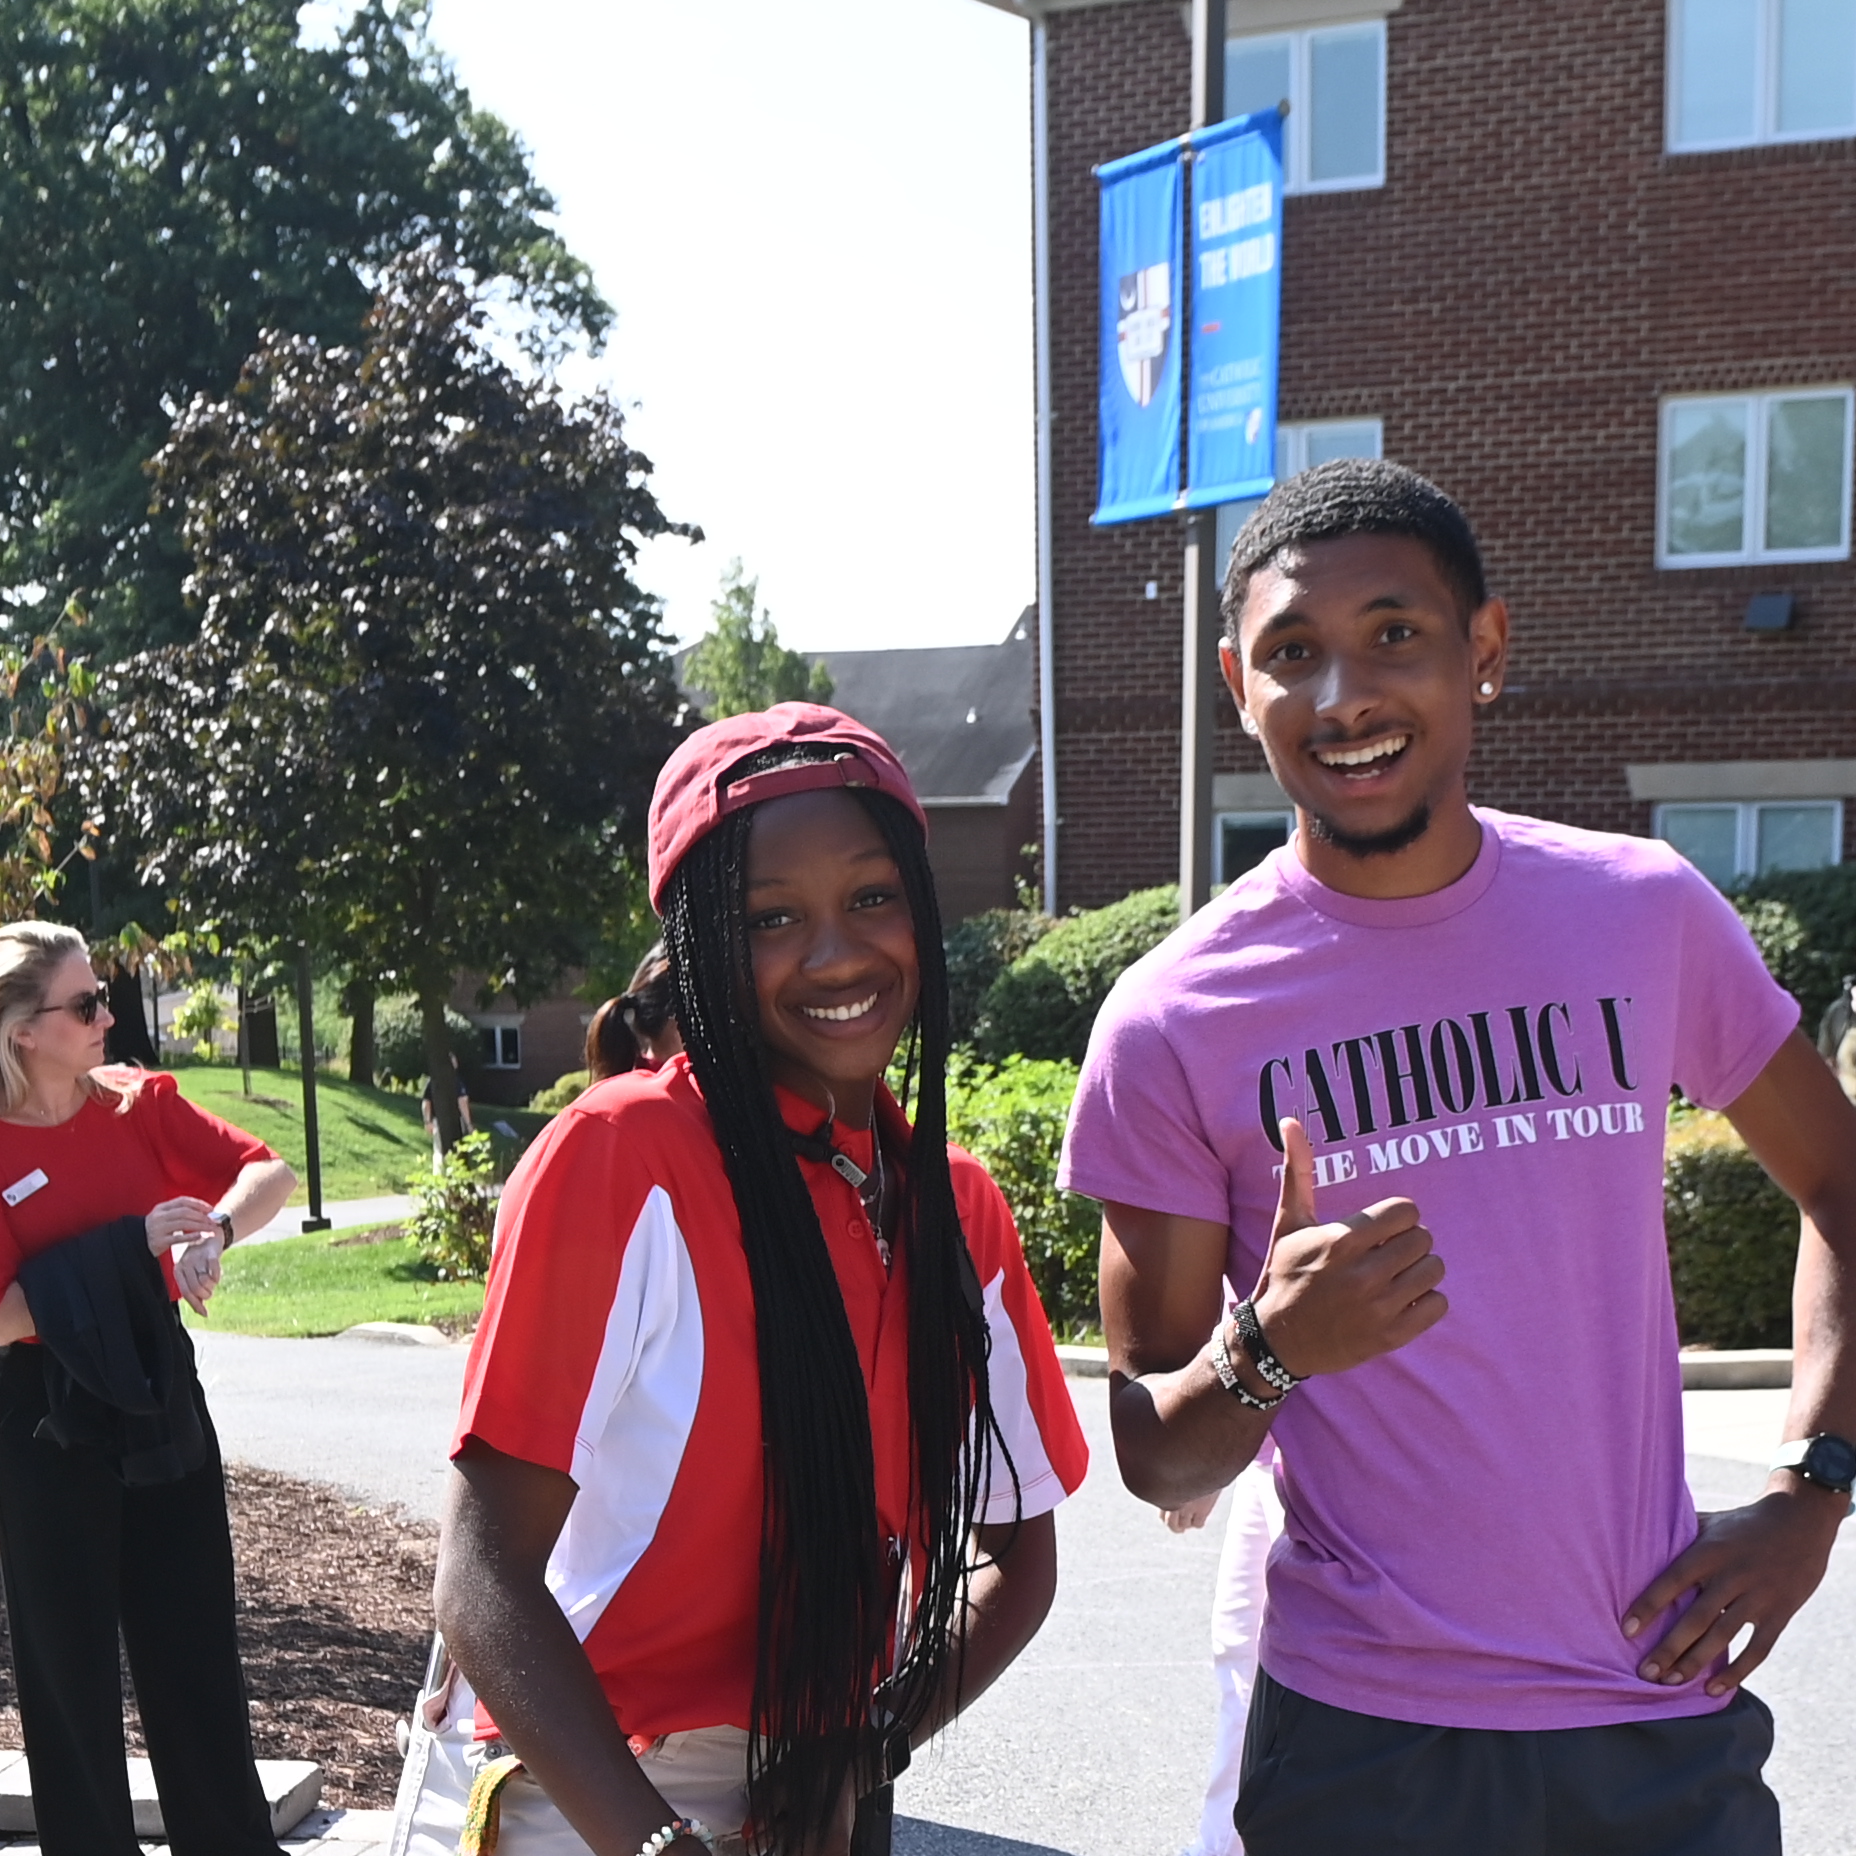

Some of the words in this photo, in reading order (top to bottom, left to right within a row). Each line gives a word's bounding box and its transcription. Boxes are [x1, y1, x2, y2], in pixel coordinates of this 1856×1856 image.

[1259, 1001, 1584, 1153] CATHOLIC
[1365, 1122, 1485, 1175] MOVE
[1494, 1111, 1538, 1149] IN
[1546, 1101, 1645, 1141] TOUR
